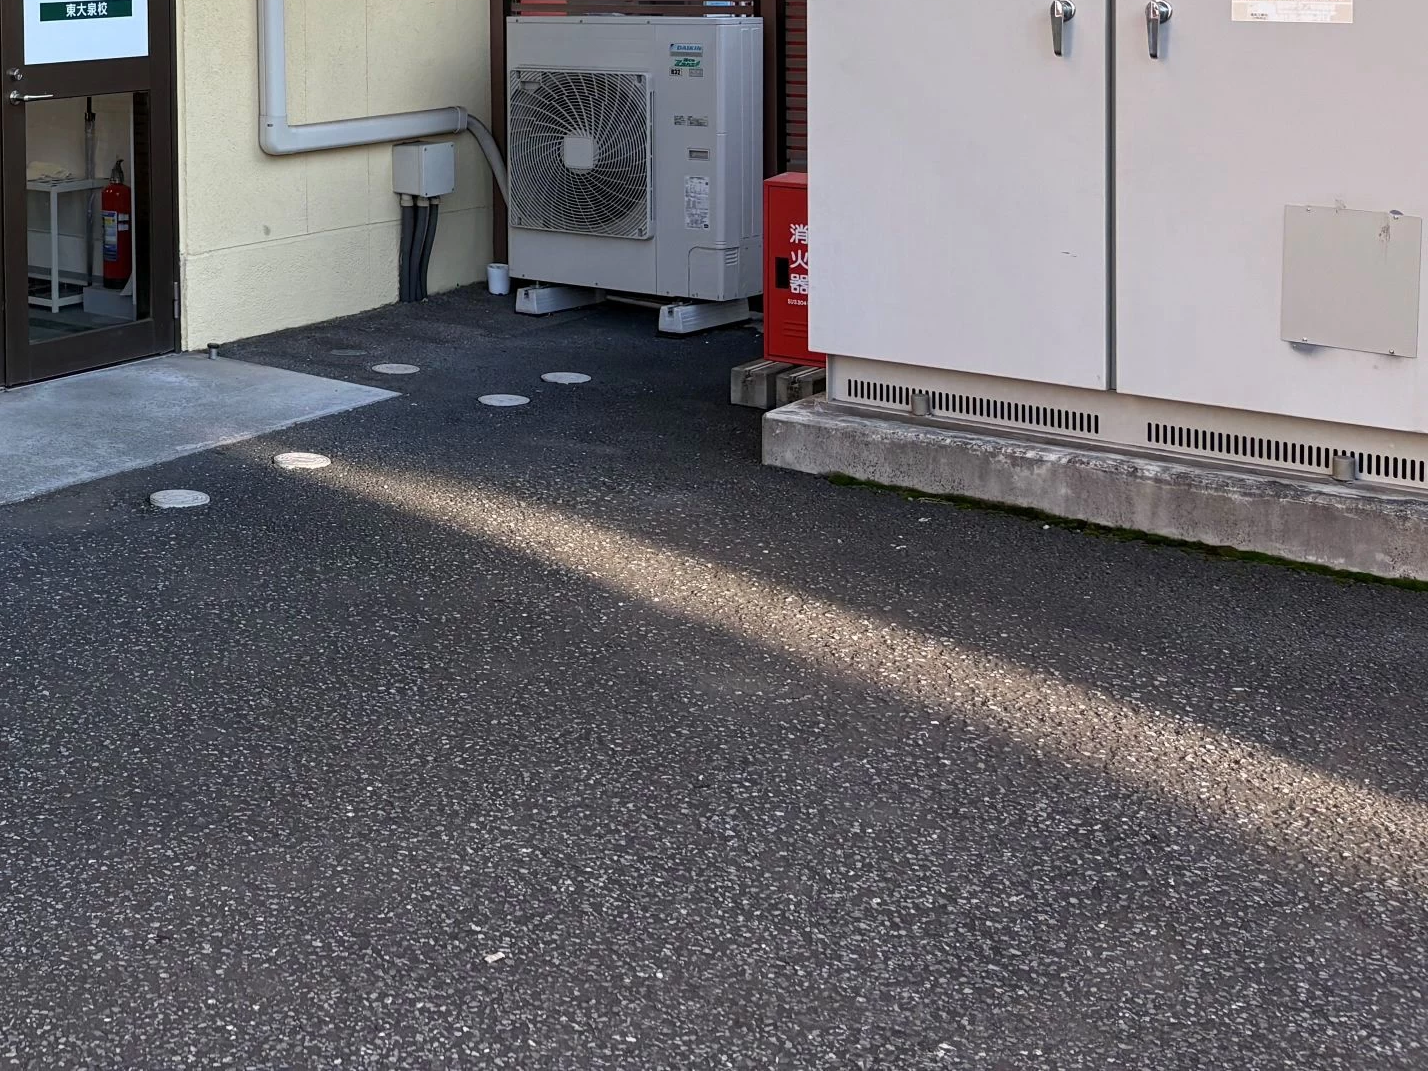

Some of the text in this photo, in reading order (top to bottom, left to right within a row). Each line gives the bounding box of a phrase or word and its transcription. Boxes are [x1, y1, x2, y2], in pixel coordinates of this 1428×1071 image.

[66, 1, 108, 18] 東大泉校
[789, 223, 809, 295] 消火器
